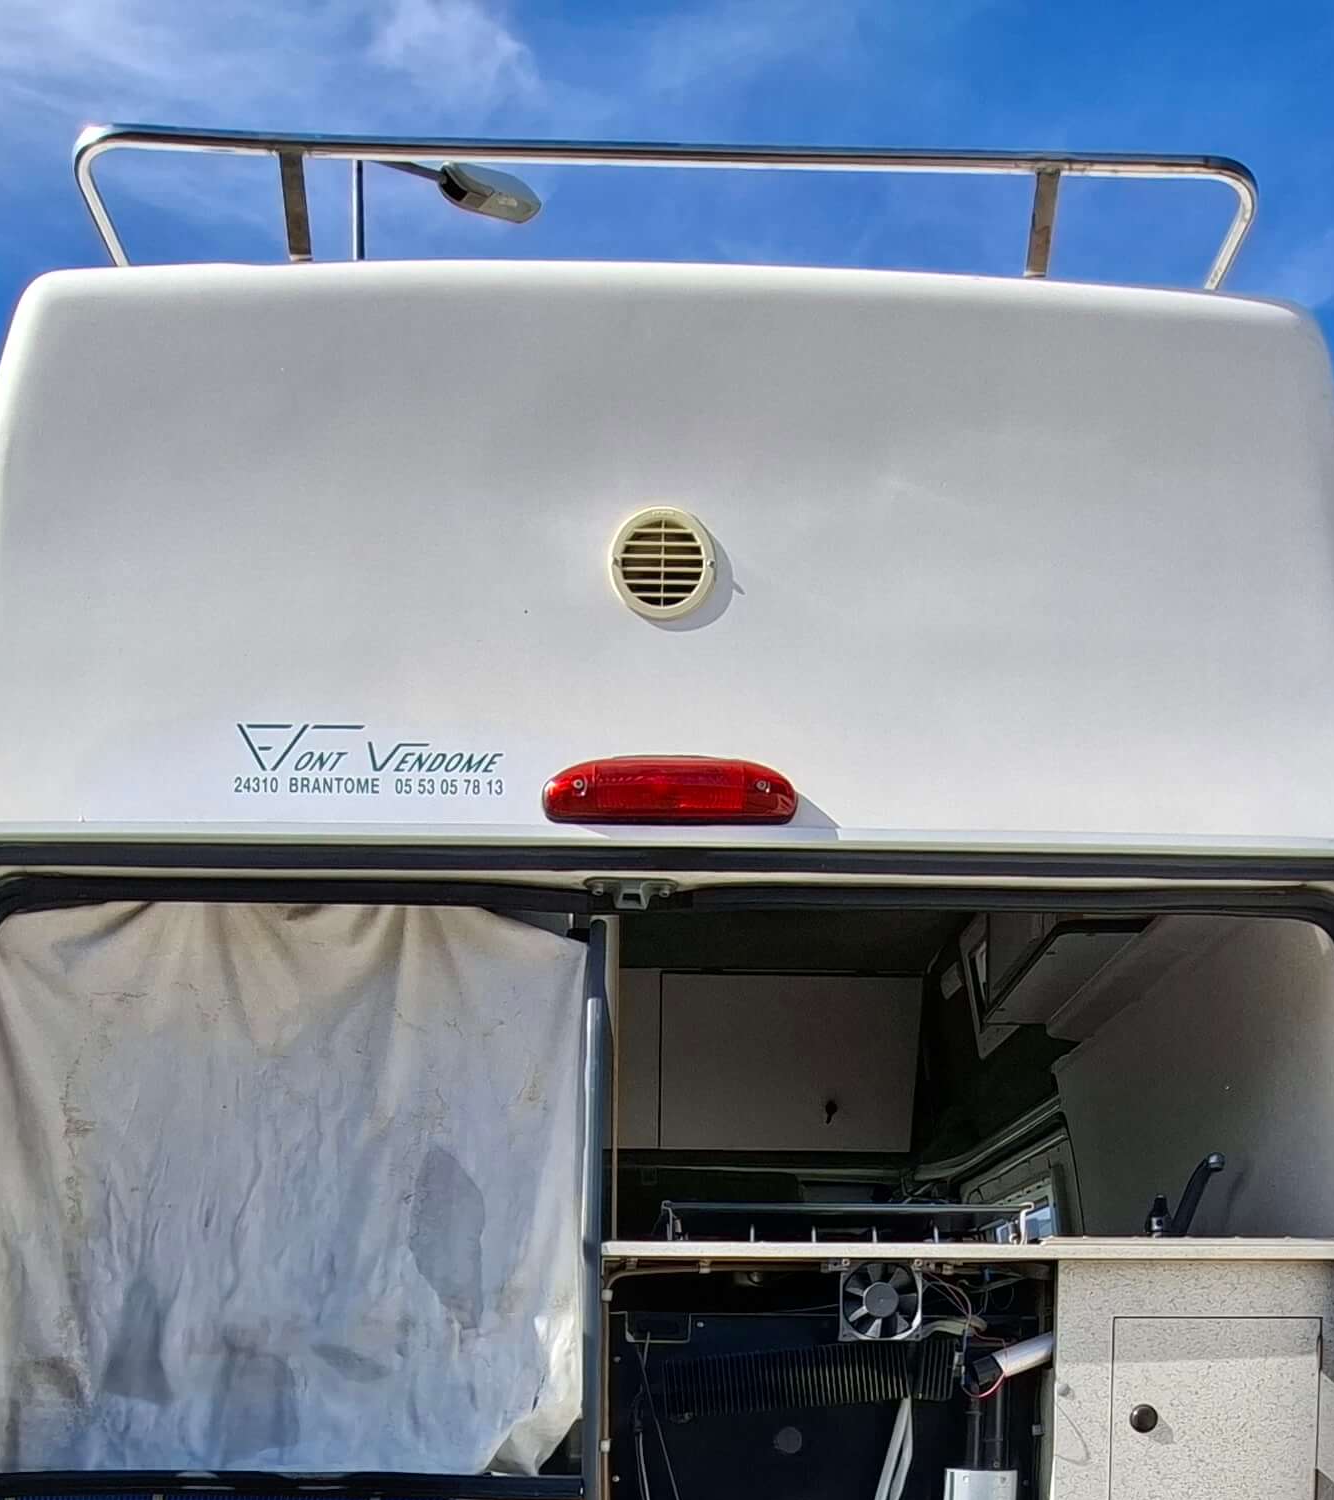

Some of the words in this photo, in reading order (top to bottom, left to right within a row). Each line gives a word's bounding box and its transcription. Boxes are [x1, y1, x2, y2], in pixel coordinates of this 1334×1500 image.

[367, 741, 504, 773] VENDOME
[233, 776, 279, 793] 24310
[289, 776, 380, 794] BRANTOME
[394, 778, 412, 795] 05
[417, 778, 435, 795] 53
[440, 778, 458, 795] 05
[463, 778, 481, 795] 78
[486, 778, 503, 796] 13
